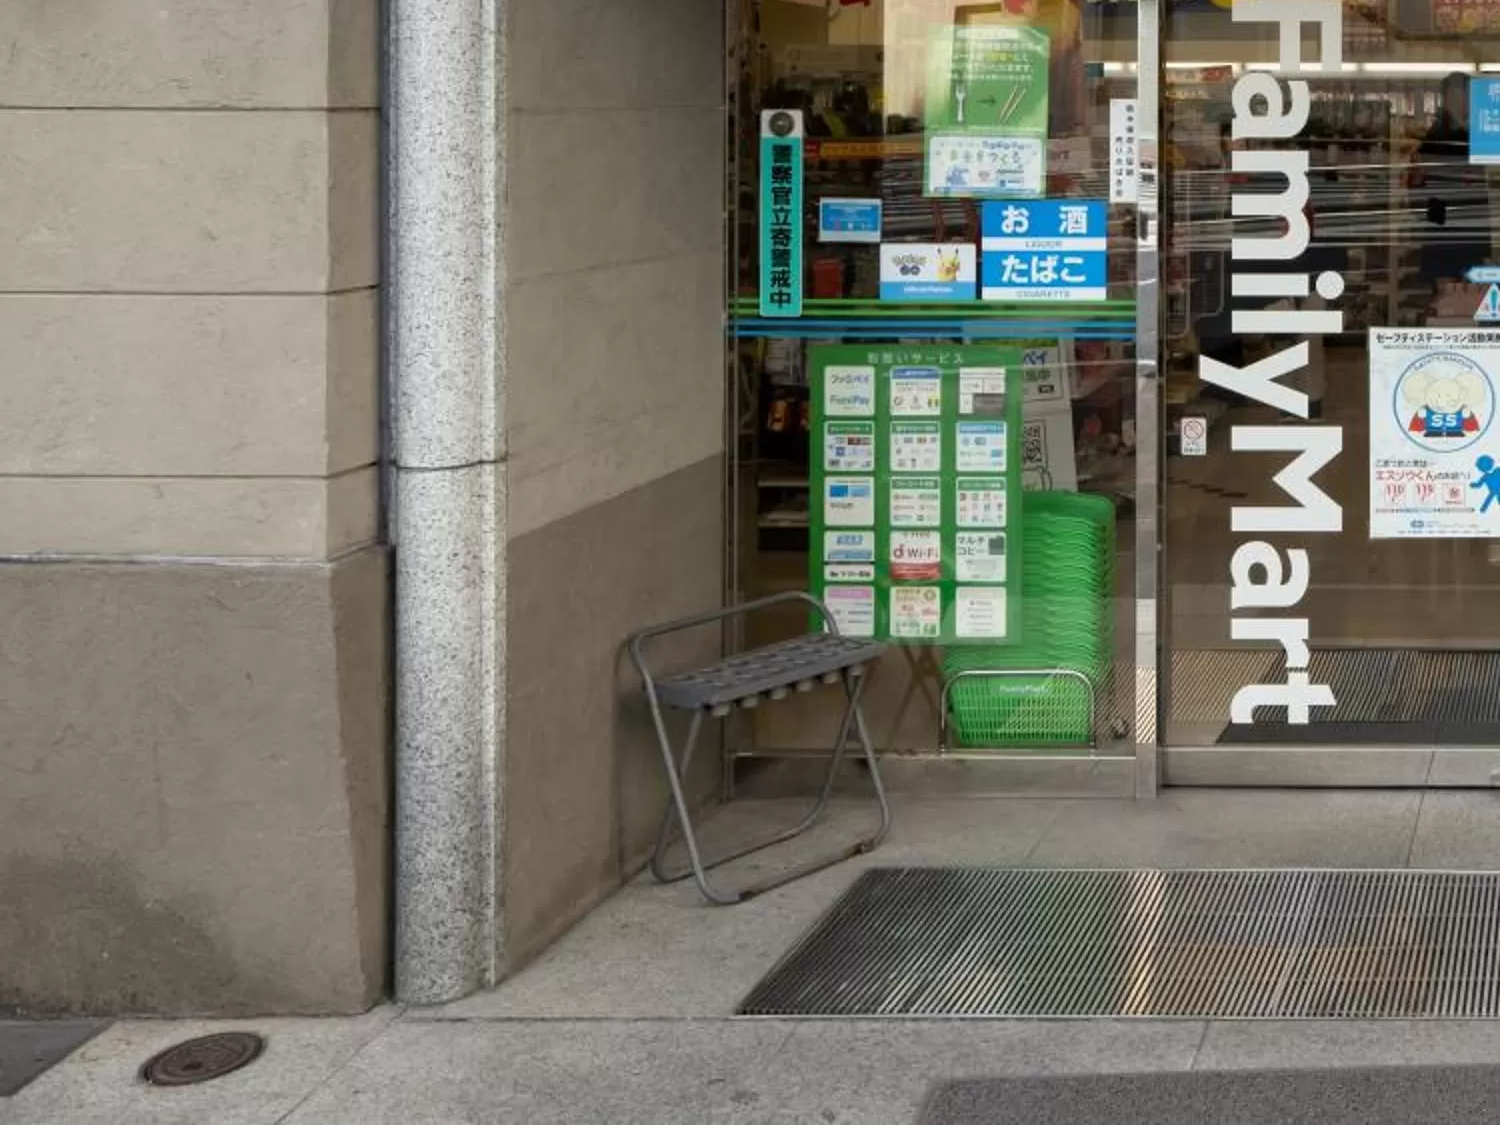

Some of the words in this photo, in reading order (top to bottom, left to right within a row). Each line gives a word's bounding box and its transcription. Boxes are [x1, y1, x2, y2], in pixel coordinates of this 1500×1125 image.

[770, 144, 793, 309] 警察官立寄警戒中
[1001, 254, 1087, 283] たばこ
